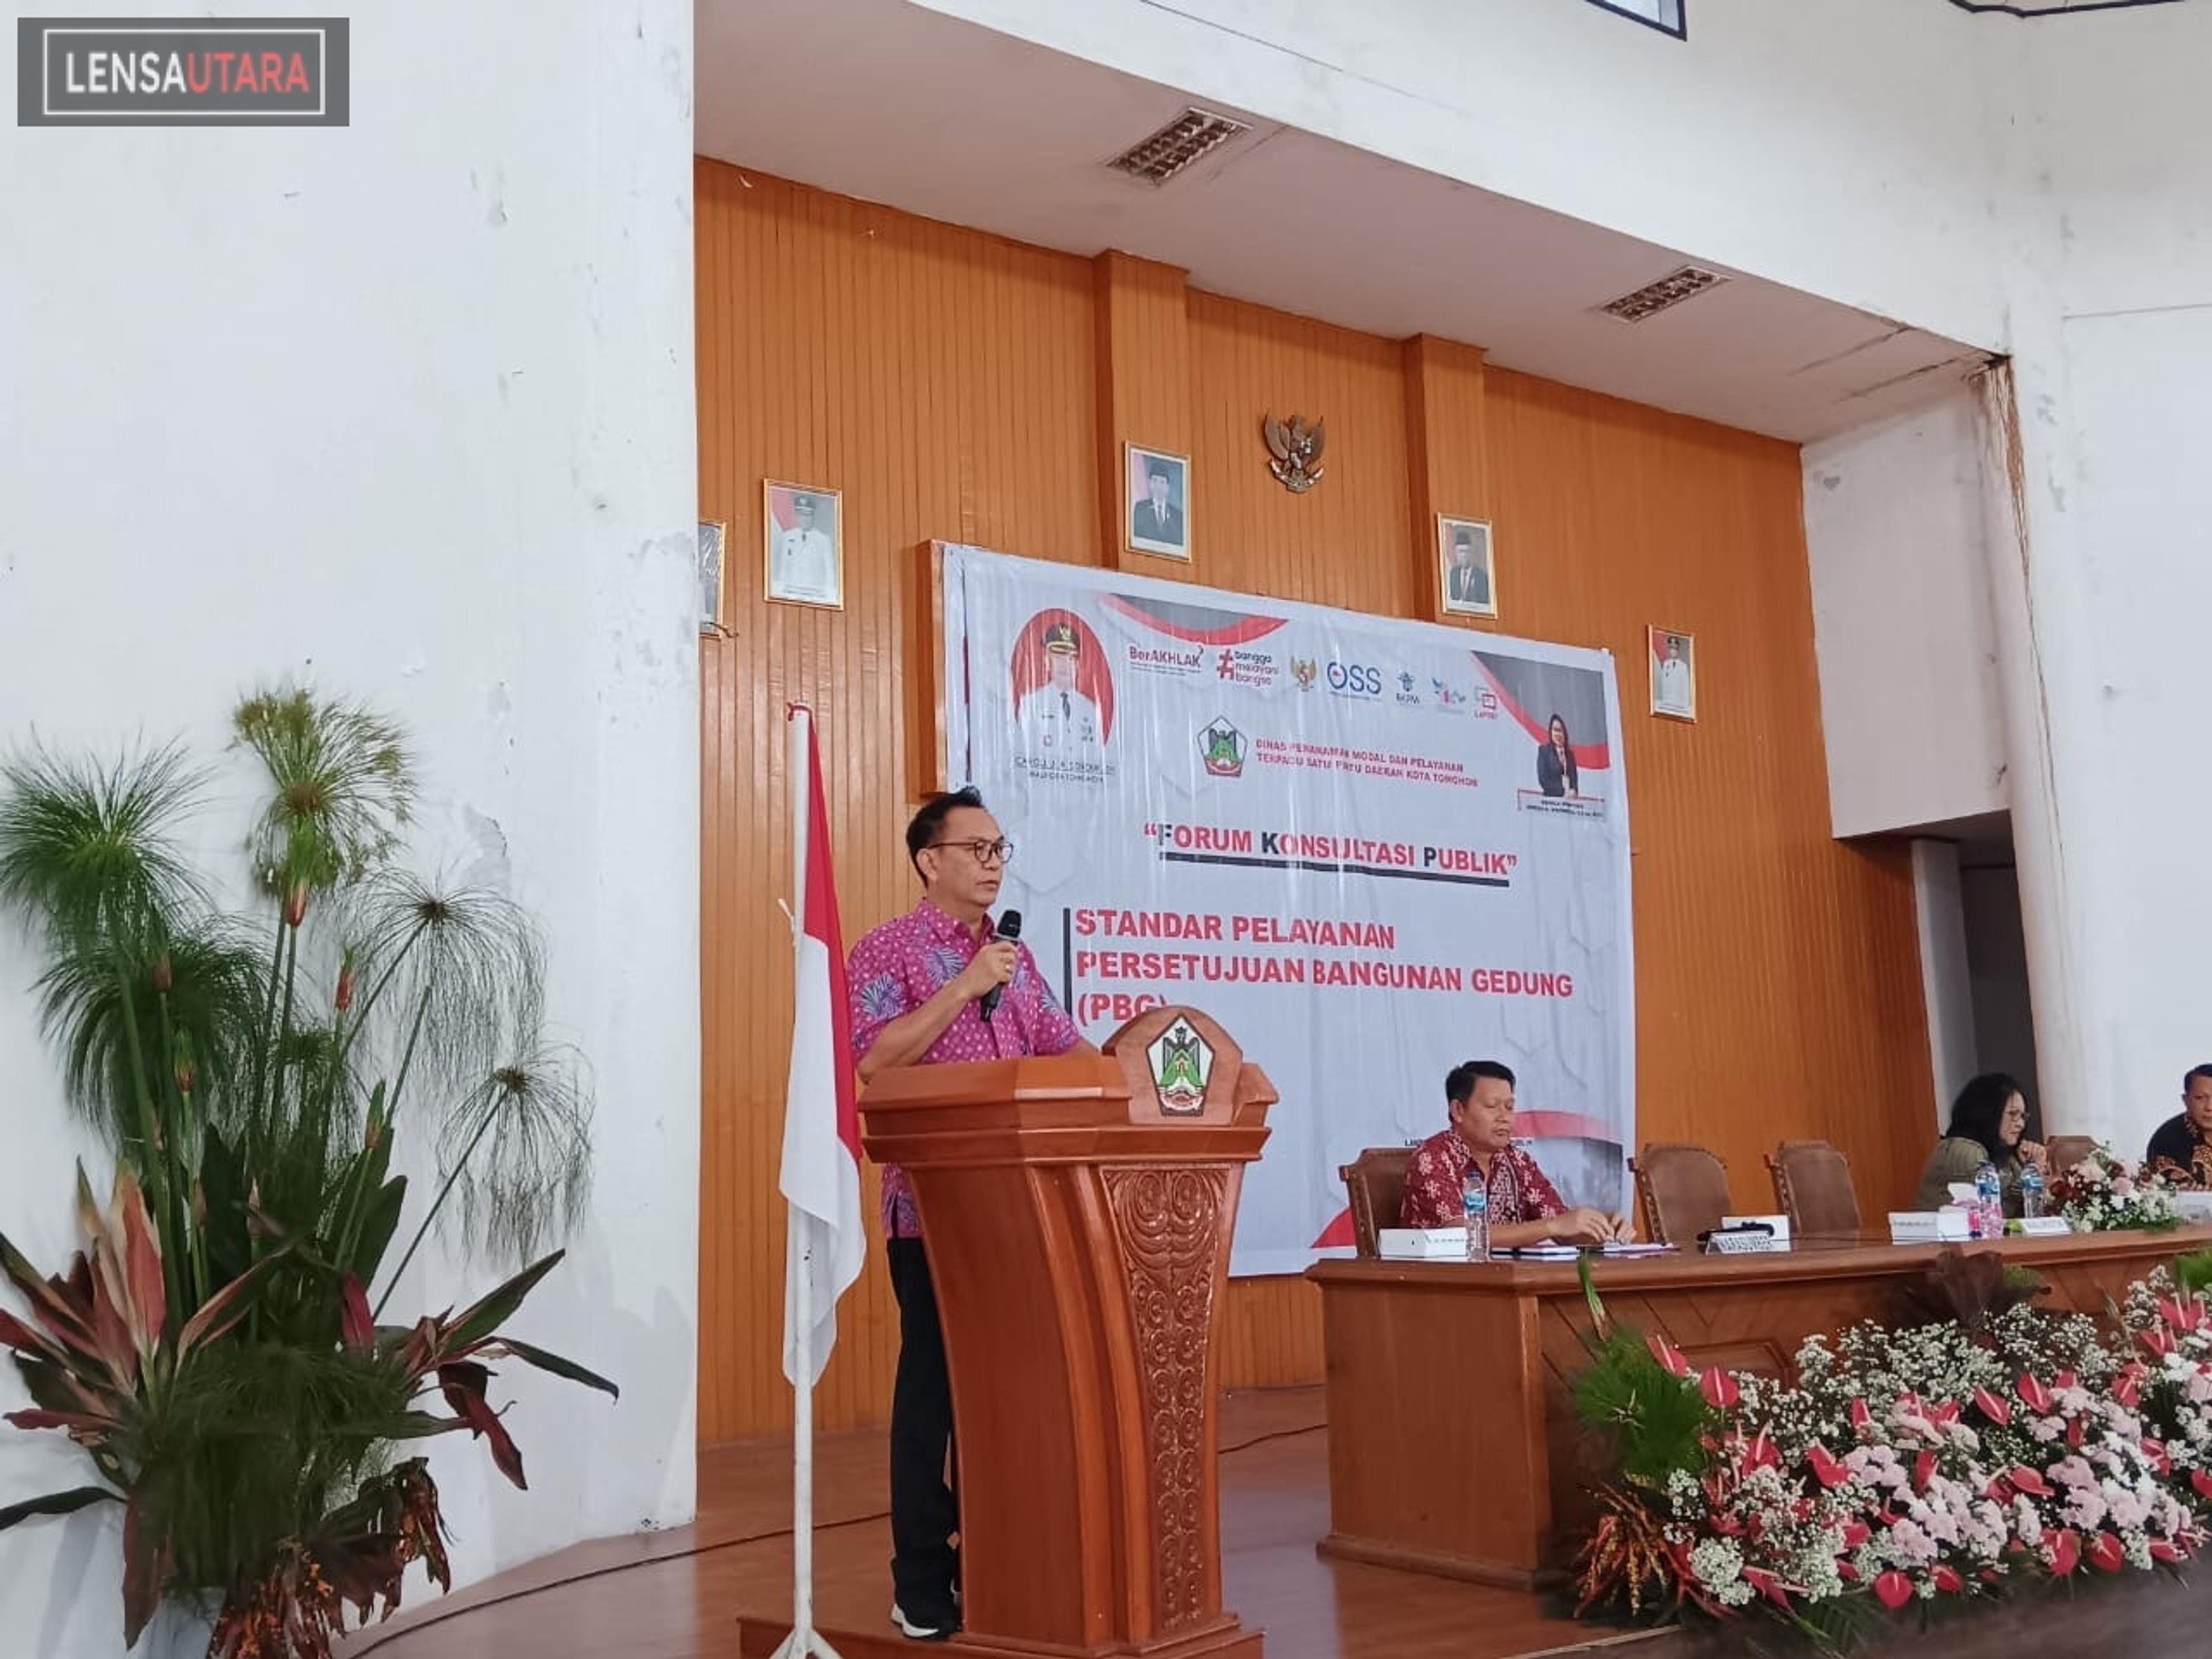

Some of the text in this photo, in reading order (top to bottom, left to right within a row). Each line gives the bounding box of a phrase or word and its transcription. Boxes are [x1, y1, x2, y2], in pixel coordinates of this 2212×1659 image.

[1130, 646, 1203, 667] BerAKHLAK
[1327, 662, 1381, 694] OSS
[1262, 831, 1415, 866] KONSULTASI
[1076, 908, 1394, 949] STANDAR PELAYANAN
[1076, 951, 1573, 998] PERSETUJUAN BANGUNAN GEDUNG
